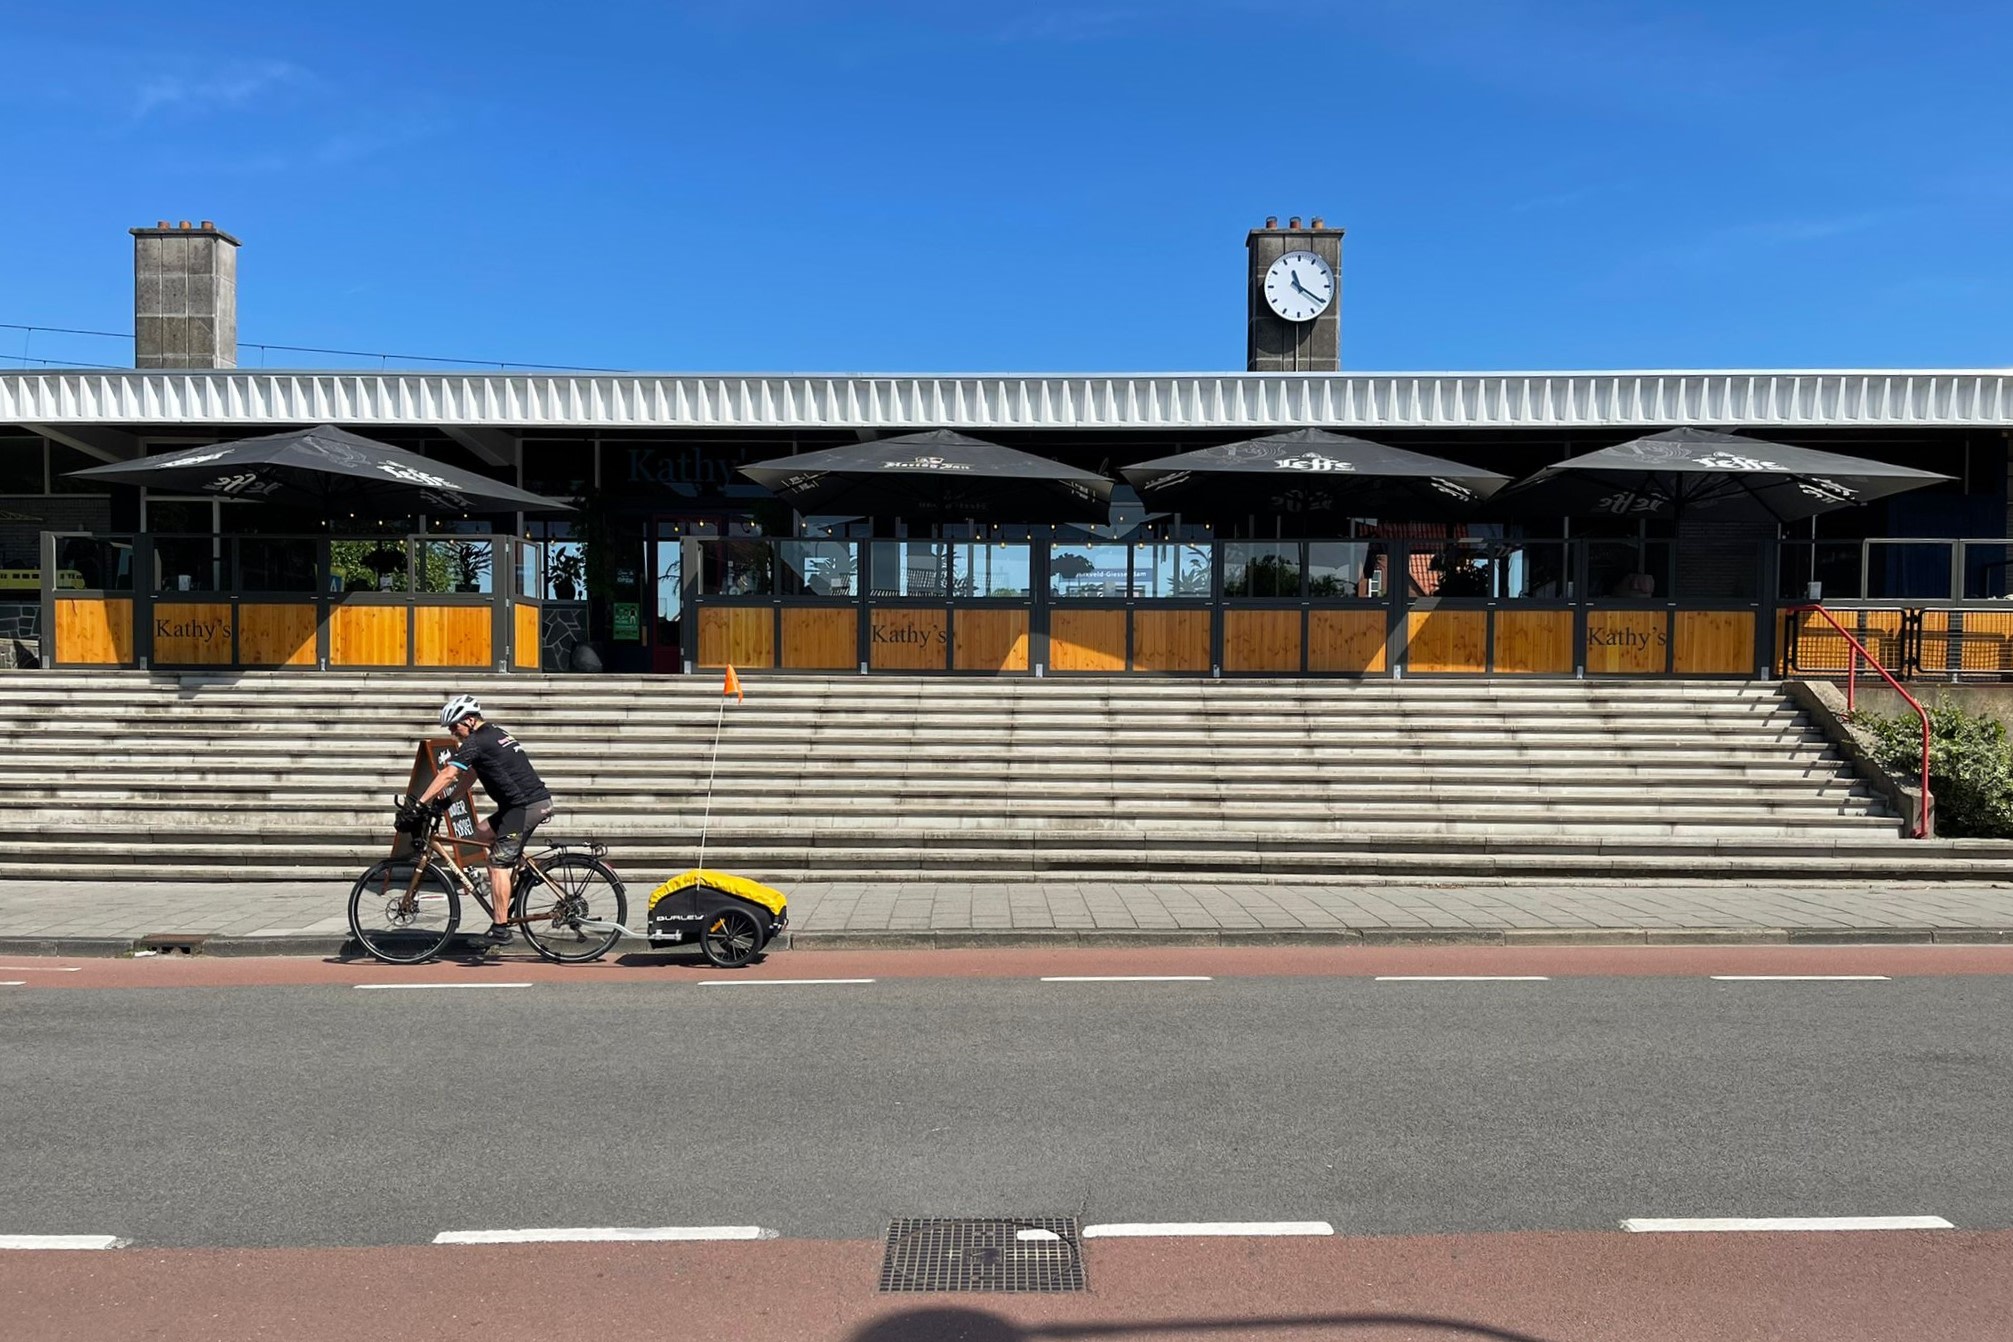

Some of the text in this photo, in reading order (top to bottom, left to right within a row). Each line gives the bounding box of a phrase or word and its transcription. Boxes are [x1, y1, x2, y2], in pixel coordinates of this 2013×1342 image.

[626, 447, 754, 491] Kathy'
[155, 618, 232, 643] Kathy's
[871, 624, 947, 649] Kathy's
[1587, 626, 1667, 652] Kathy's
[656, 914, 704, 922] BURLEY
